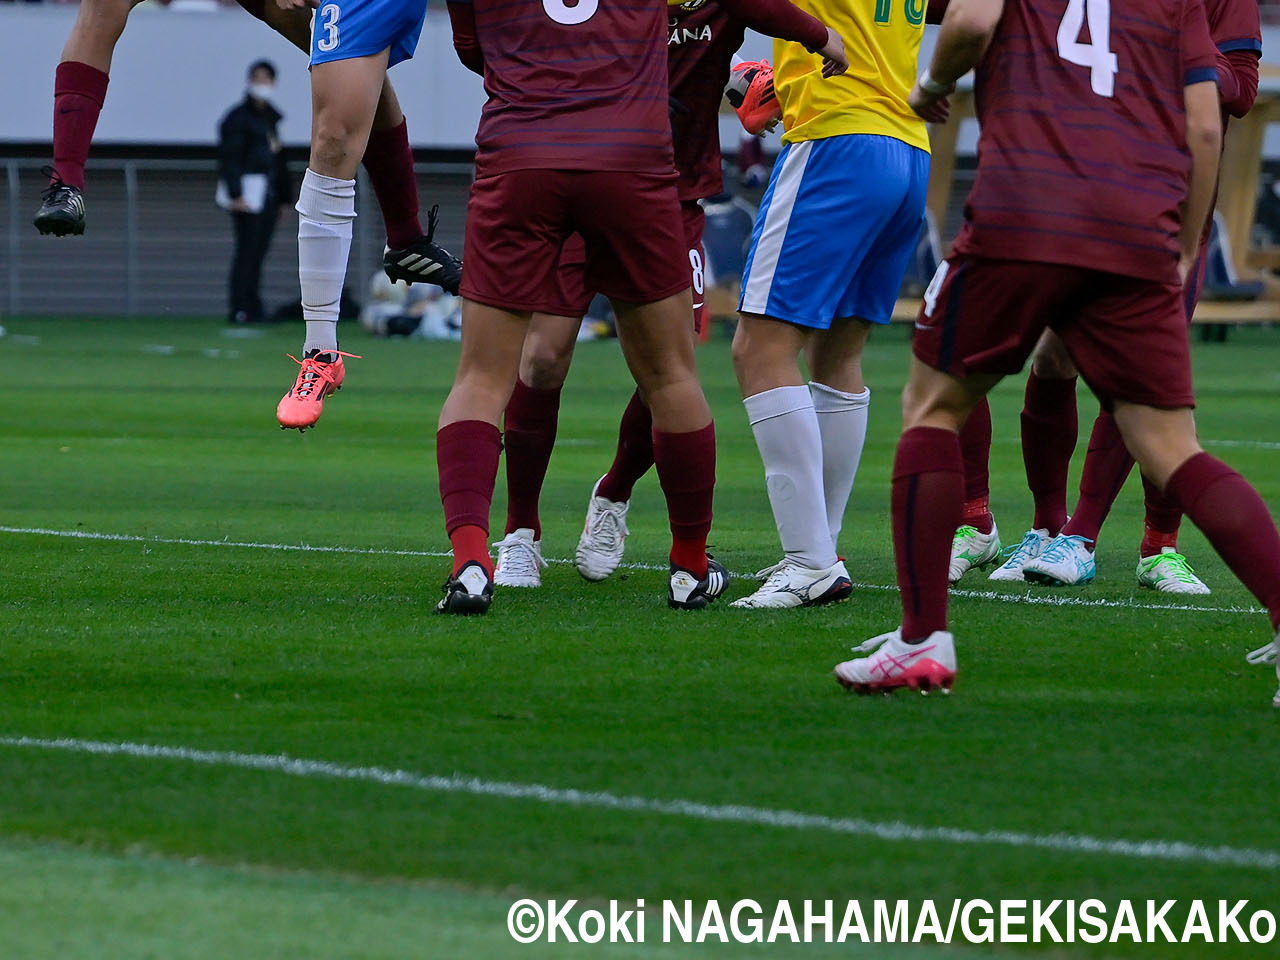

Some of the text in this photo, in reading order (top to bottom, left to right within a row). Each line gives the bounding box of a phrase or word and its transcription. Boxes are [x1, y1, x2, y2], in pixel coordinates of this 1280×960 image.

[317, 3, 341, 52] 3
[666, 24, 713, 46] ANA
[688, 248, 704, 295] 8
[923, 259, 951, 318] 4
